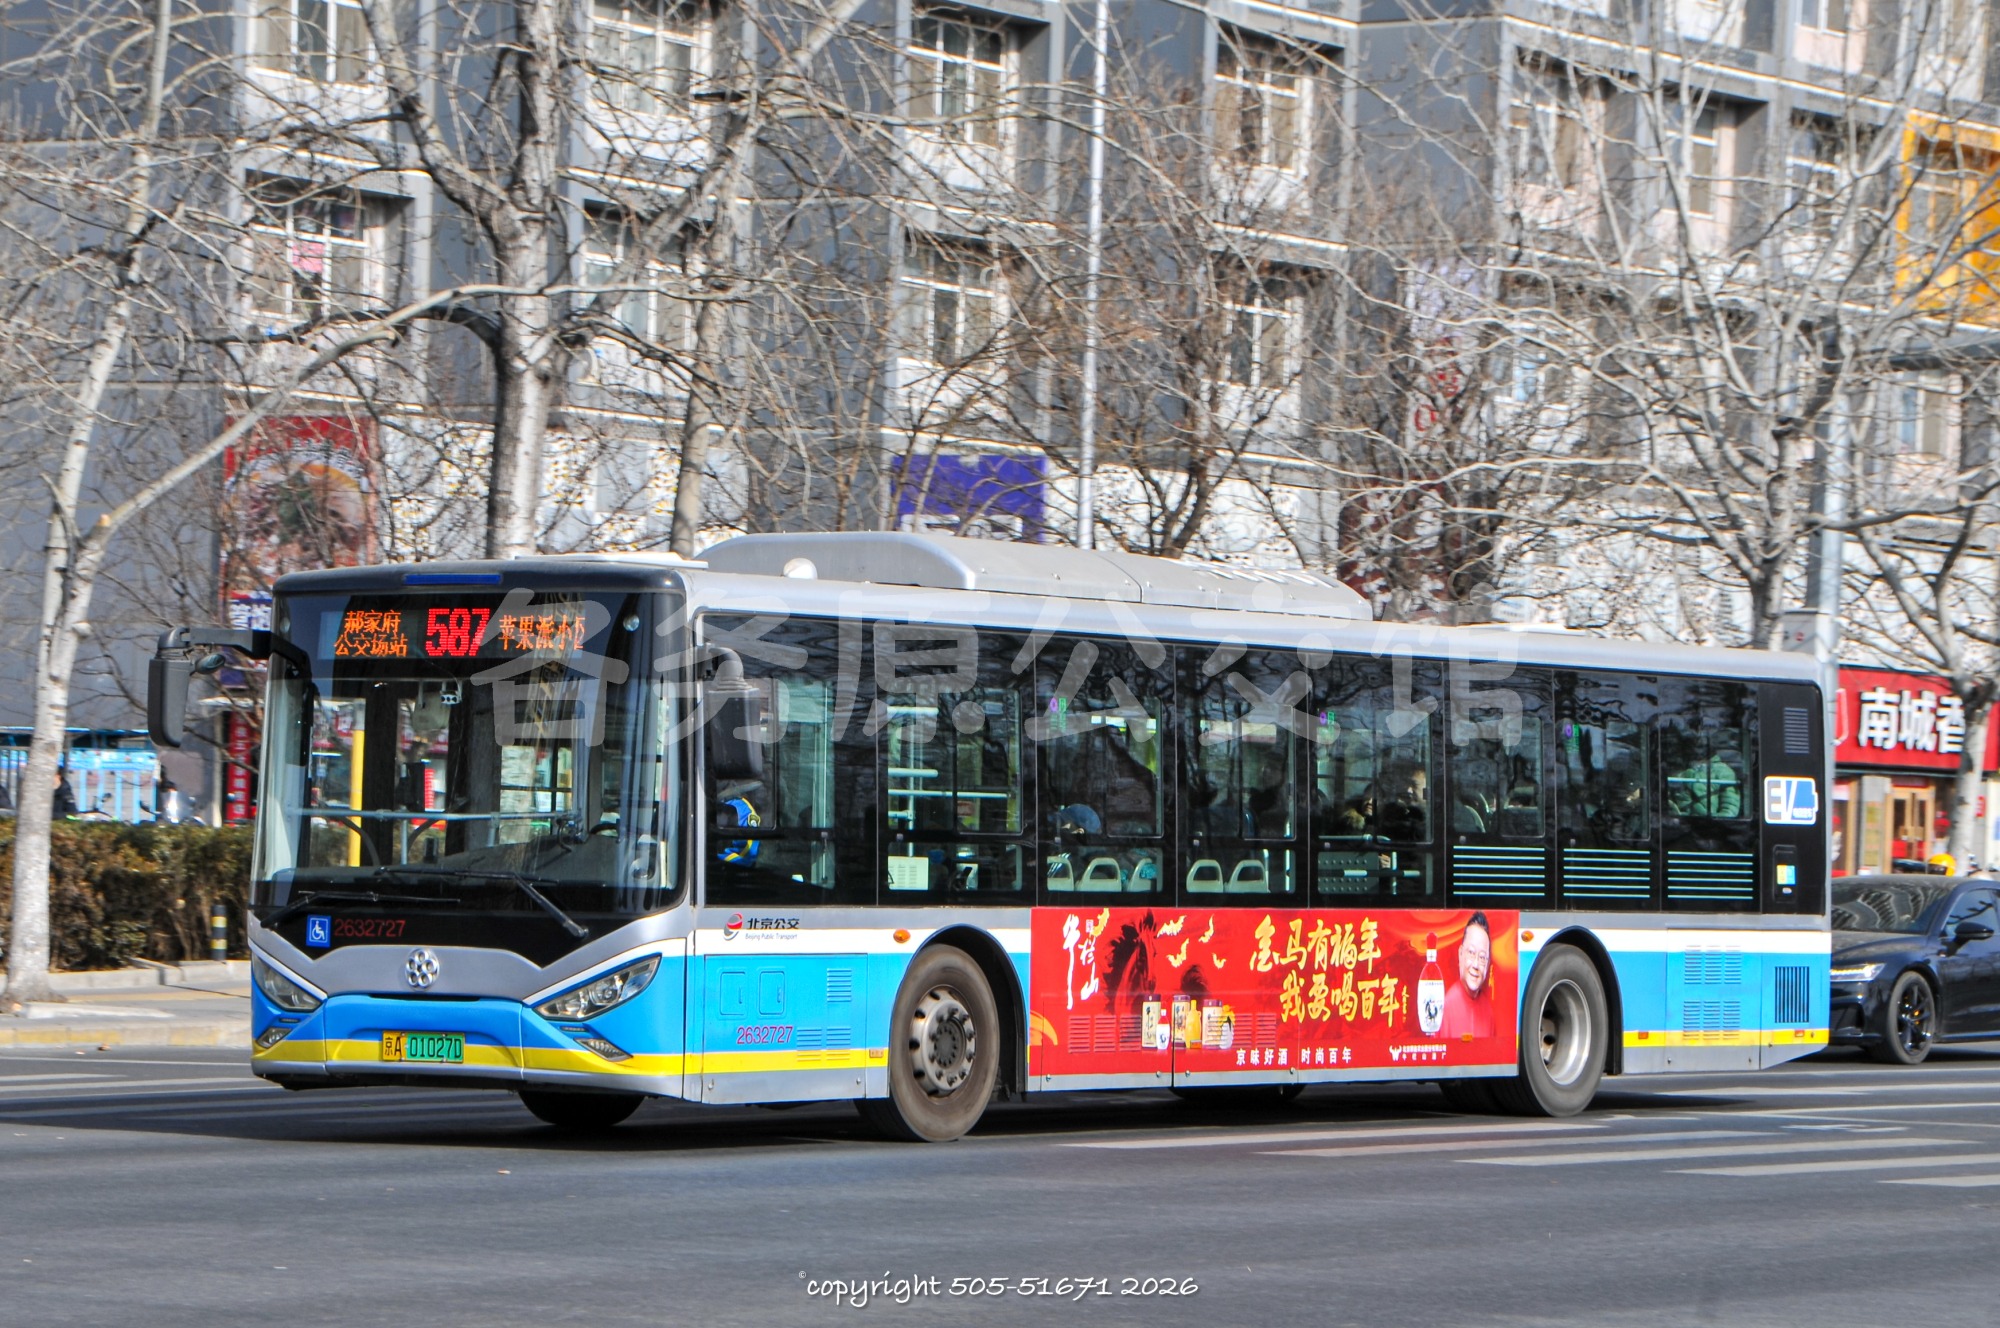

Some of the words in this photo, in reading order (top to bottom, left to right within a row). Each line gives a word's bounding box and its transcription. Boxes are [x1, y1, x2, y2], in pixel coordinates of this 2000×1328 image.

[344, 609, 402, 633] 郝家府
[425, 608, 490, 657] 587
[333, 632, 408, 658] 公交场站
[1858, 686, 1966, 754] 南城香
[334, 918, 406, 937] 2632727
[747, 918, 800, 930] 北京公交
[745, 933, 760, 941] Beijing
[1279, 969, 1400, 1028] 我要喝百年
[736, 1026, 793, 1044] 2632727
[1236, 1048, 1288, 1066] 京味好酒
[1301, 1046, 1352, 1065] 时尚百年
